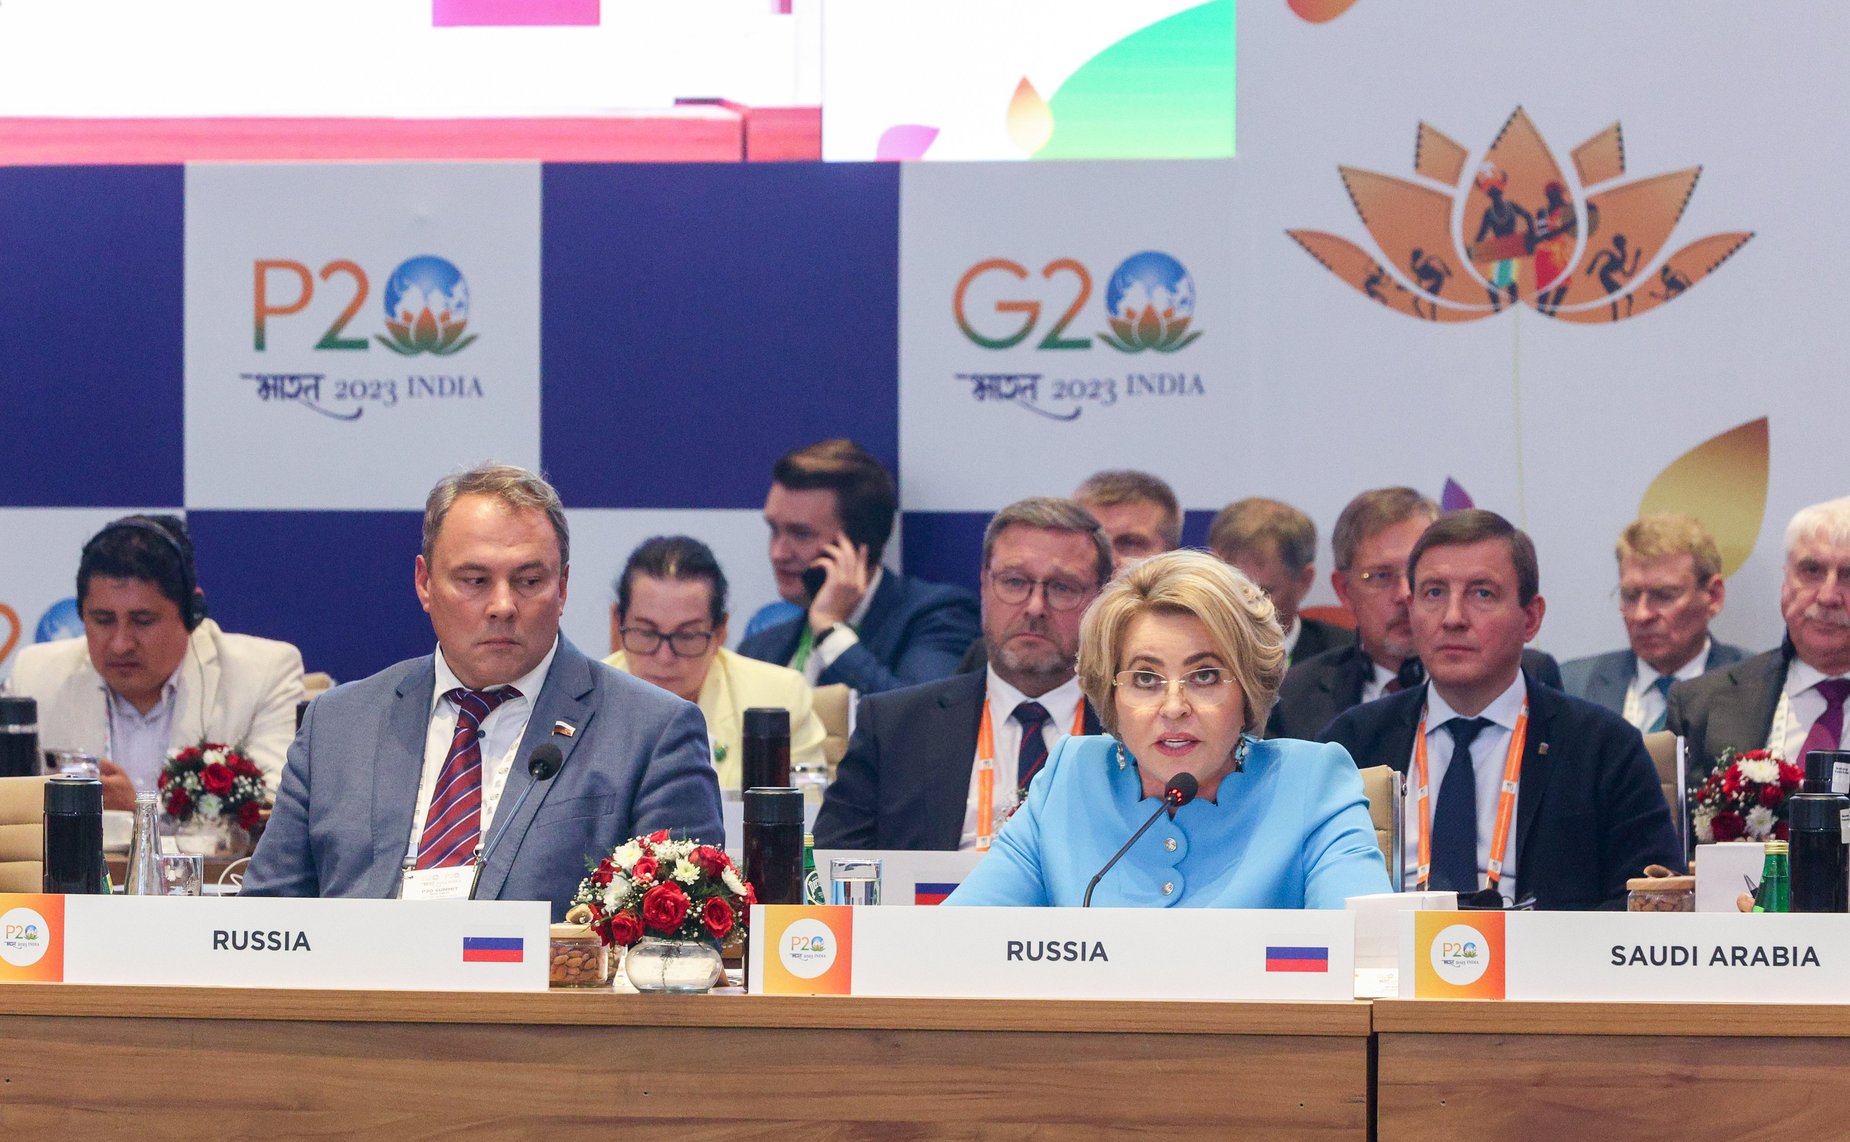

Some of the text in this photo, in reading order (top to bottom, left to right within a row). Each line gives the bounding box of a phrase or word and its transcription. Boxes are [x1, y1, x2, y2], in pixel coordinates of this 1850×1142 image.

[953, 250, 1204, 354] G20
[335, 379, 398, 407] 2023
[407, 375, 484, 399] INDIA
[1053, 378, 1117, 405] 2023
[1126, 373, 1205, 397] INDIA
[213, 930, 311, 952] RUSSIA
[1007, 940, 1109, 962] RUSSIA
[1610, 945, 1821, 967] SAUDI ARABIA
